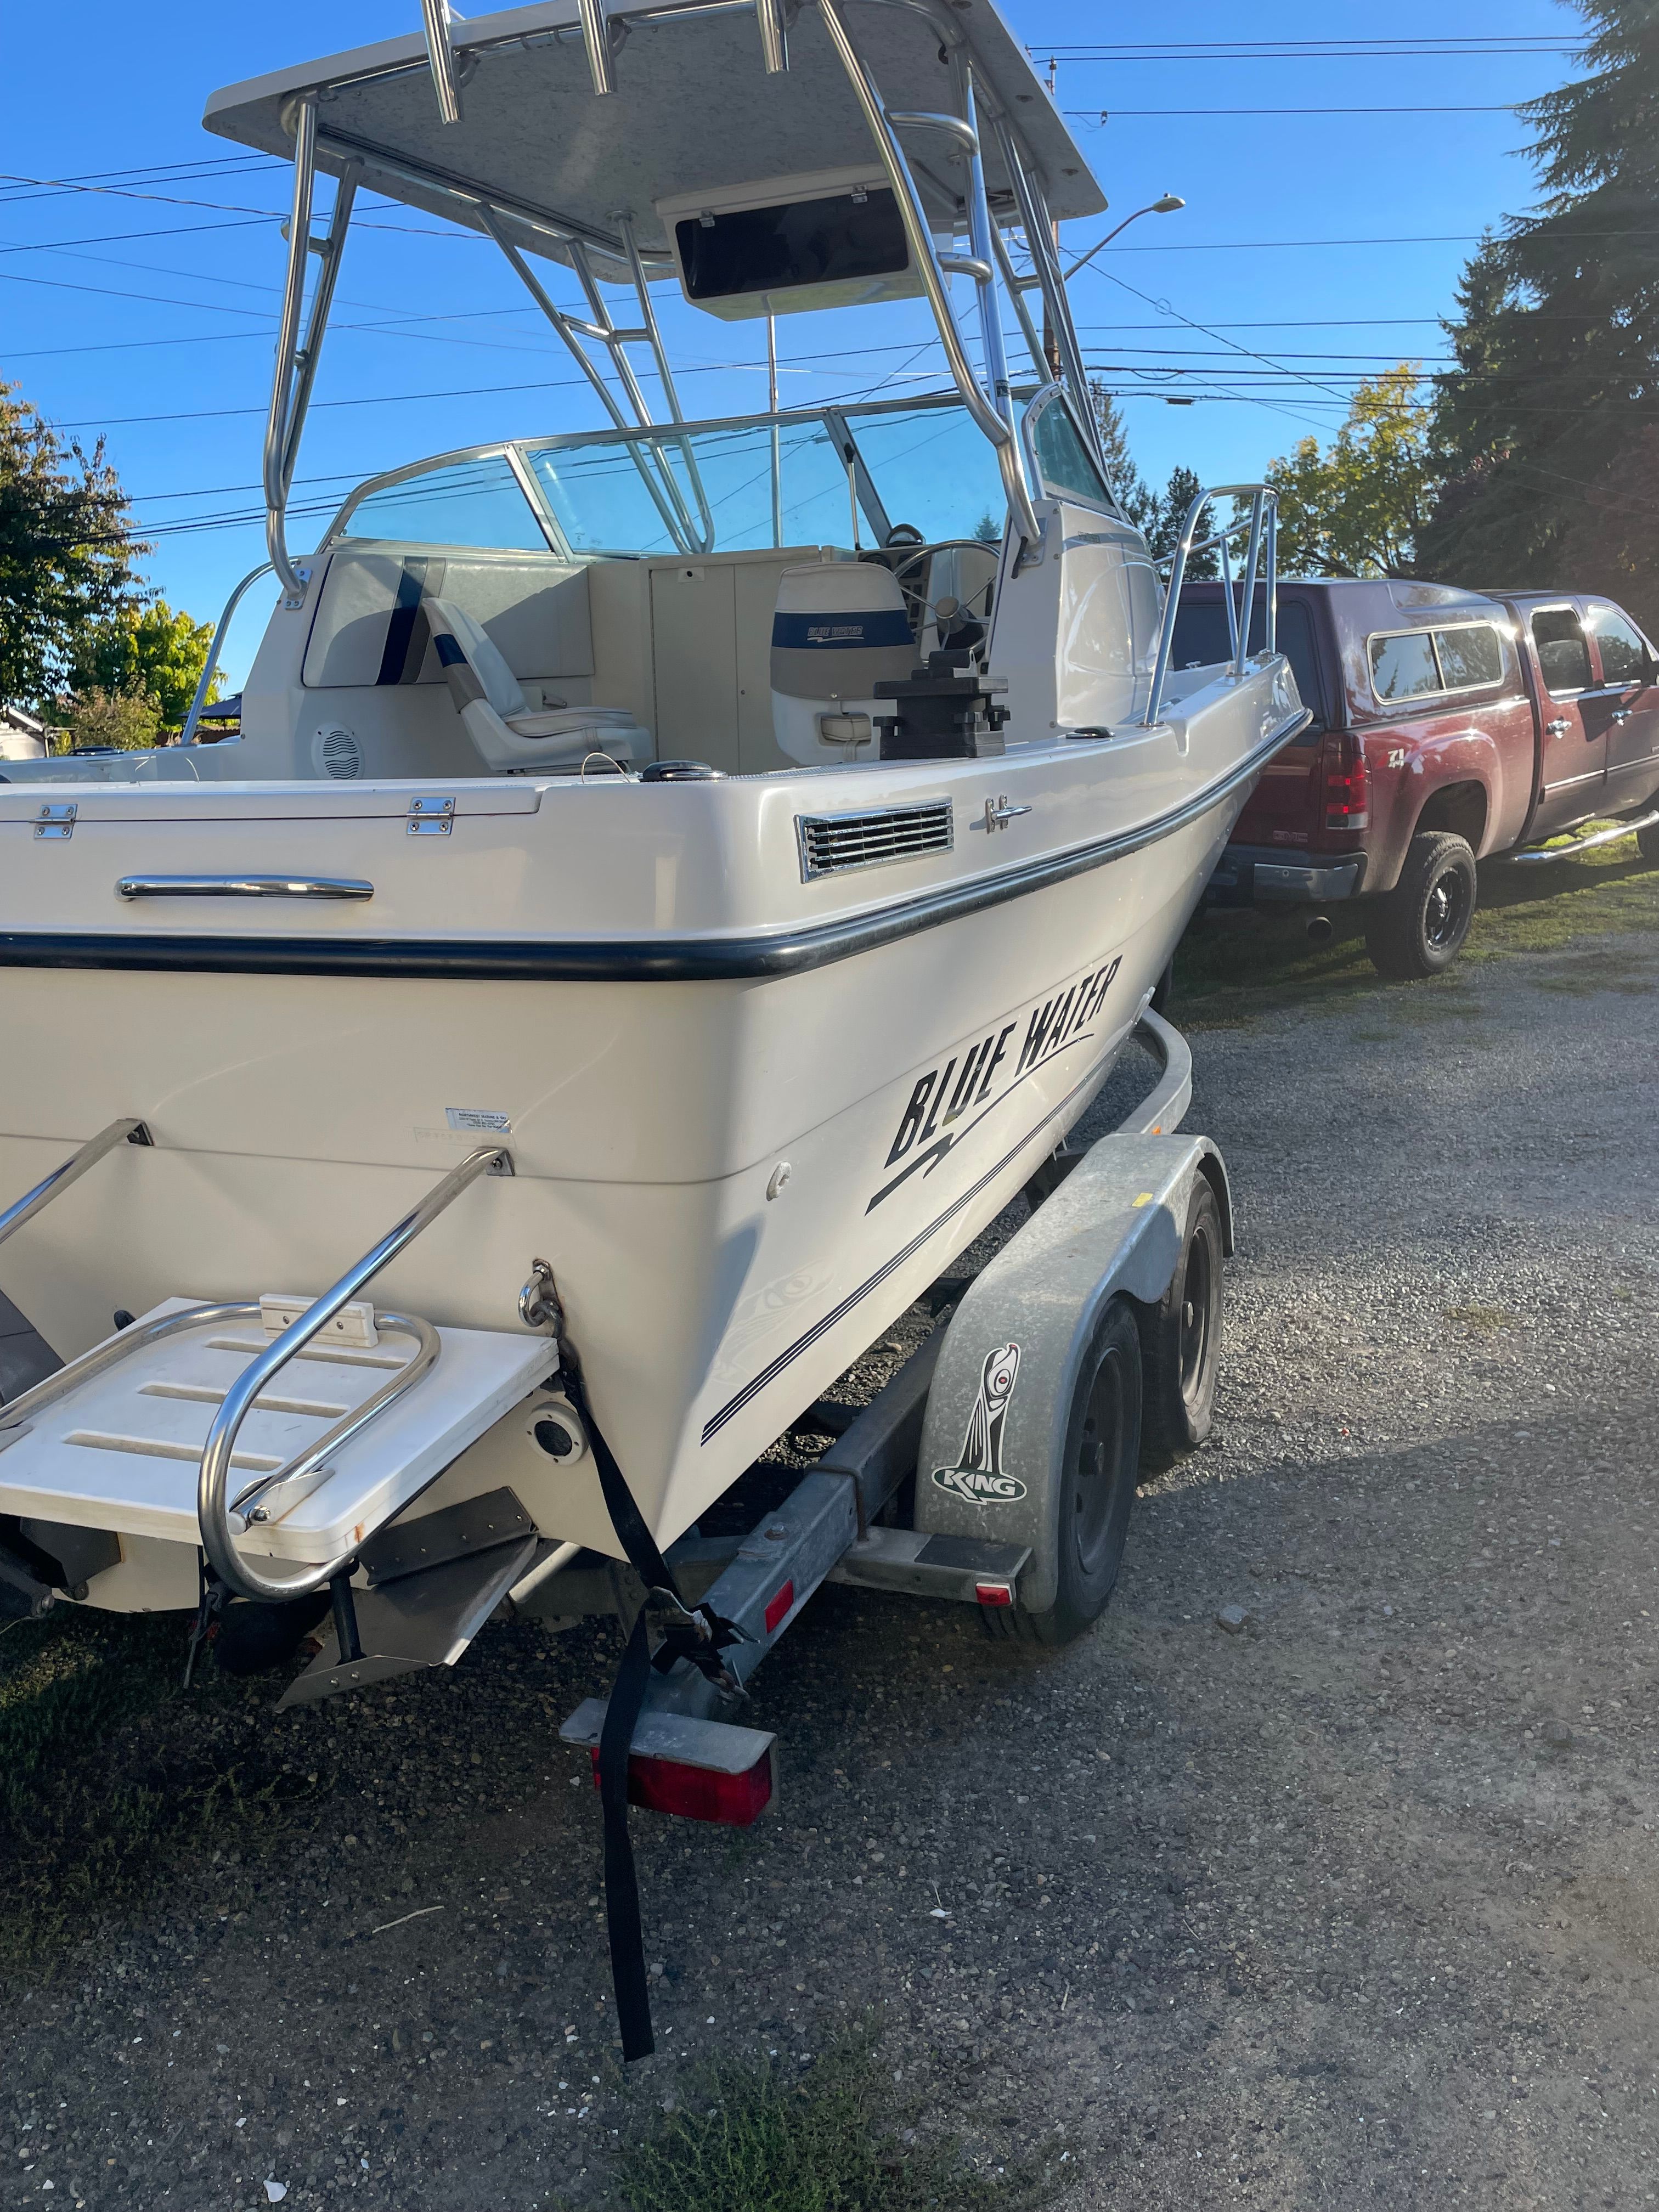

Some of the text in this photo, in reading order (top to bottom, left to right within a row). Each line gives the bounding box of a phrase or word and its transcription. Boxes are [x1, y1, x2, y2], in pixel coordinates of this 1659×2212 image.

[808, 625, 863, 636] BLUE WATER
[1273, 830, 1308, 843] GMC
[884, 954, 1123, 1169] BLUE WATER
[944, 1470, 1016, 1501] KING
